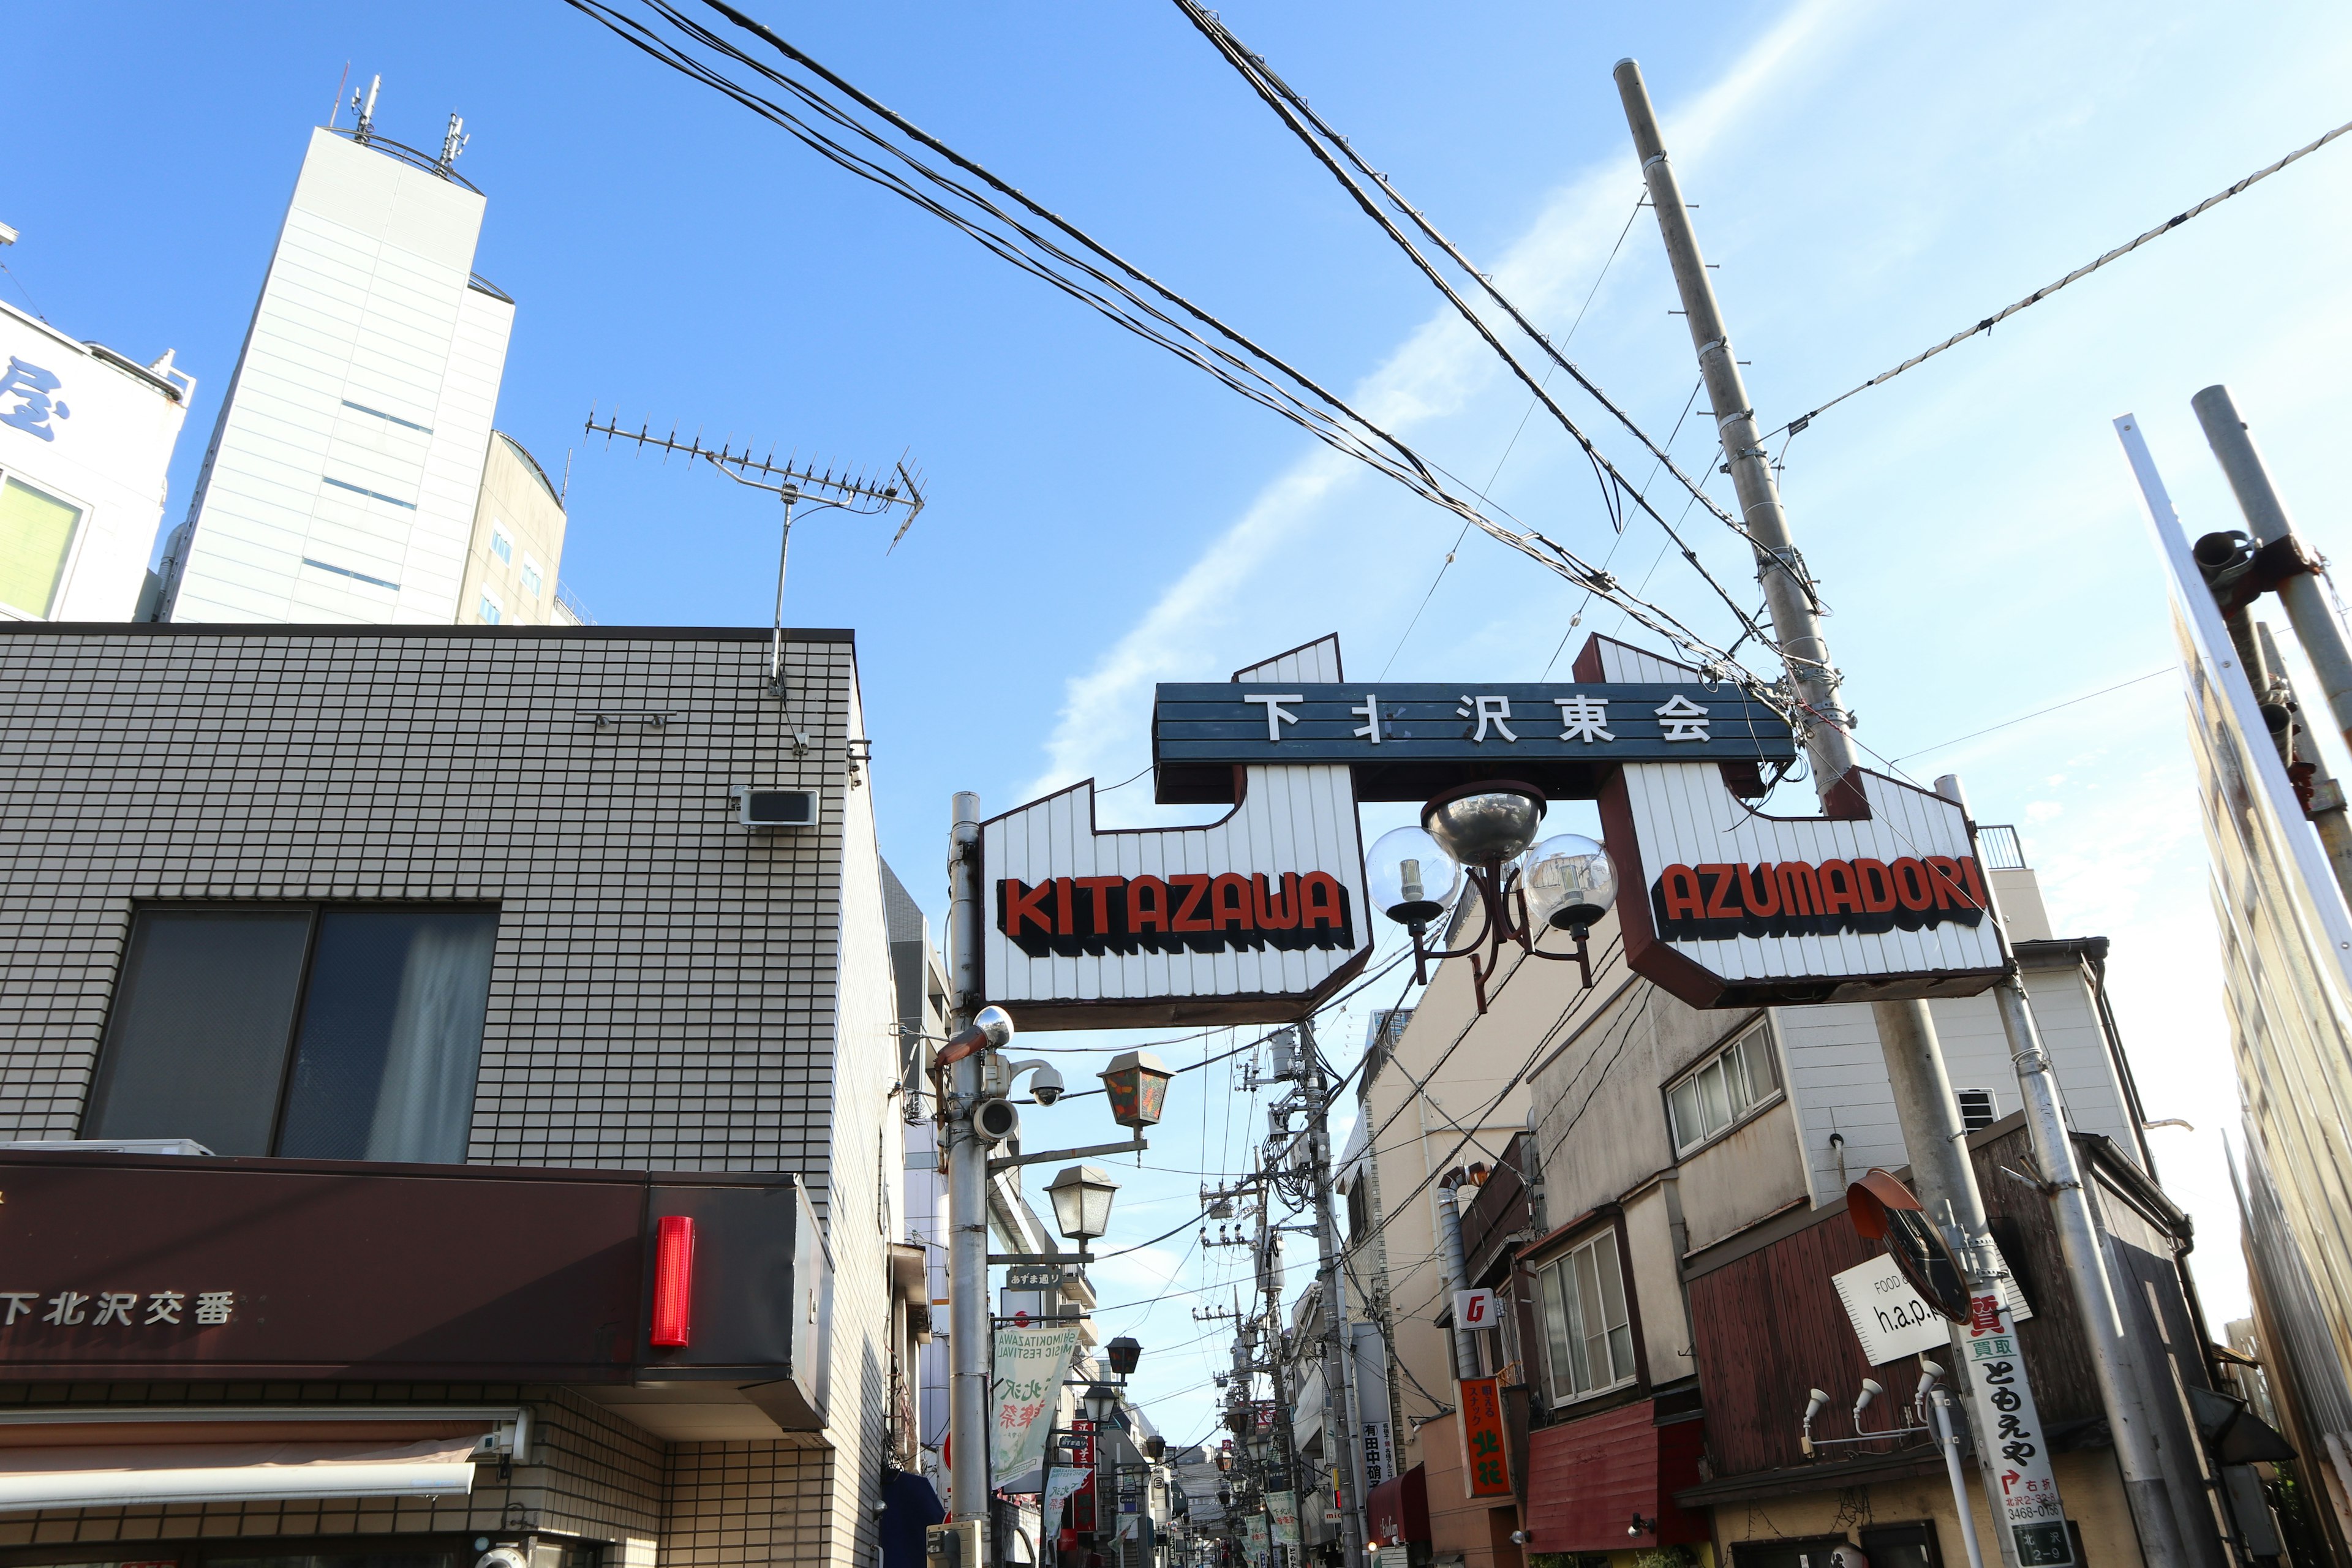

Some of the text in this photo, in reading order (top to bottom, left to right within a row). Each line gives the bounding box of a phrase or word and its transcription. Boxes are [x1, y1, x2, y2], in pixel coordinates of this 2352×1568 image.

[1666, 856, 1986, 920] AZUMADORI
[1005, 870, 1343, 937] KITAZAWA
[1011, 1272, 1059, 1284] あずま通り
[1874, 1275, 1901, 1295] FOOD
[0, 1290, 234, 1327] 下北沢交番
[1466, 1295, 1485, 1323] G
[1970, 1295, 2005, 1337] 質
[1973, 1340, 2012, 1358] 買取
[1469, 1387, 1482, 1426] スナック
[1482, 1385, 1494, 1417] 唄える
[1982, 1361, 2036, 1467] ともえや
[2025, 1479, 2051, 1492] 右折
[2008, 1504, 2059, 1520] 3468-0156
[2023, 1532, 2062, 1546] 北沢
